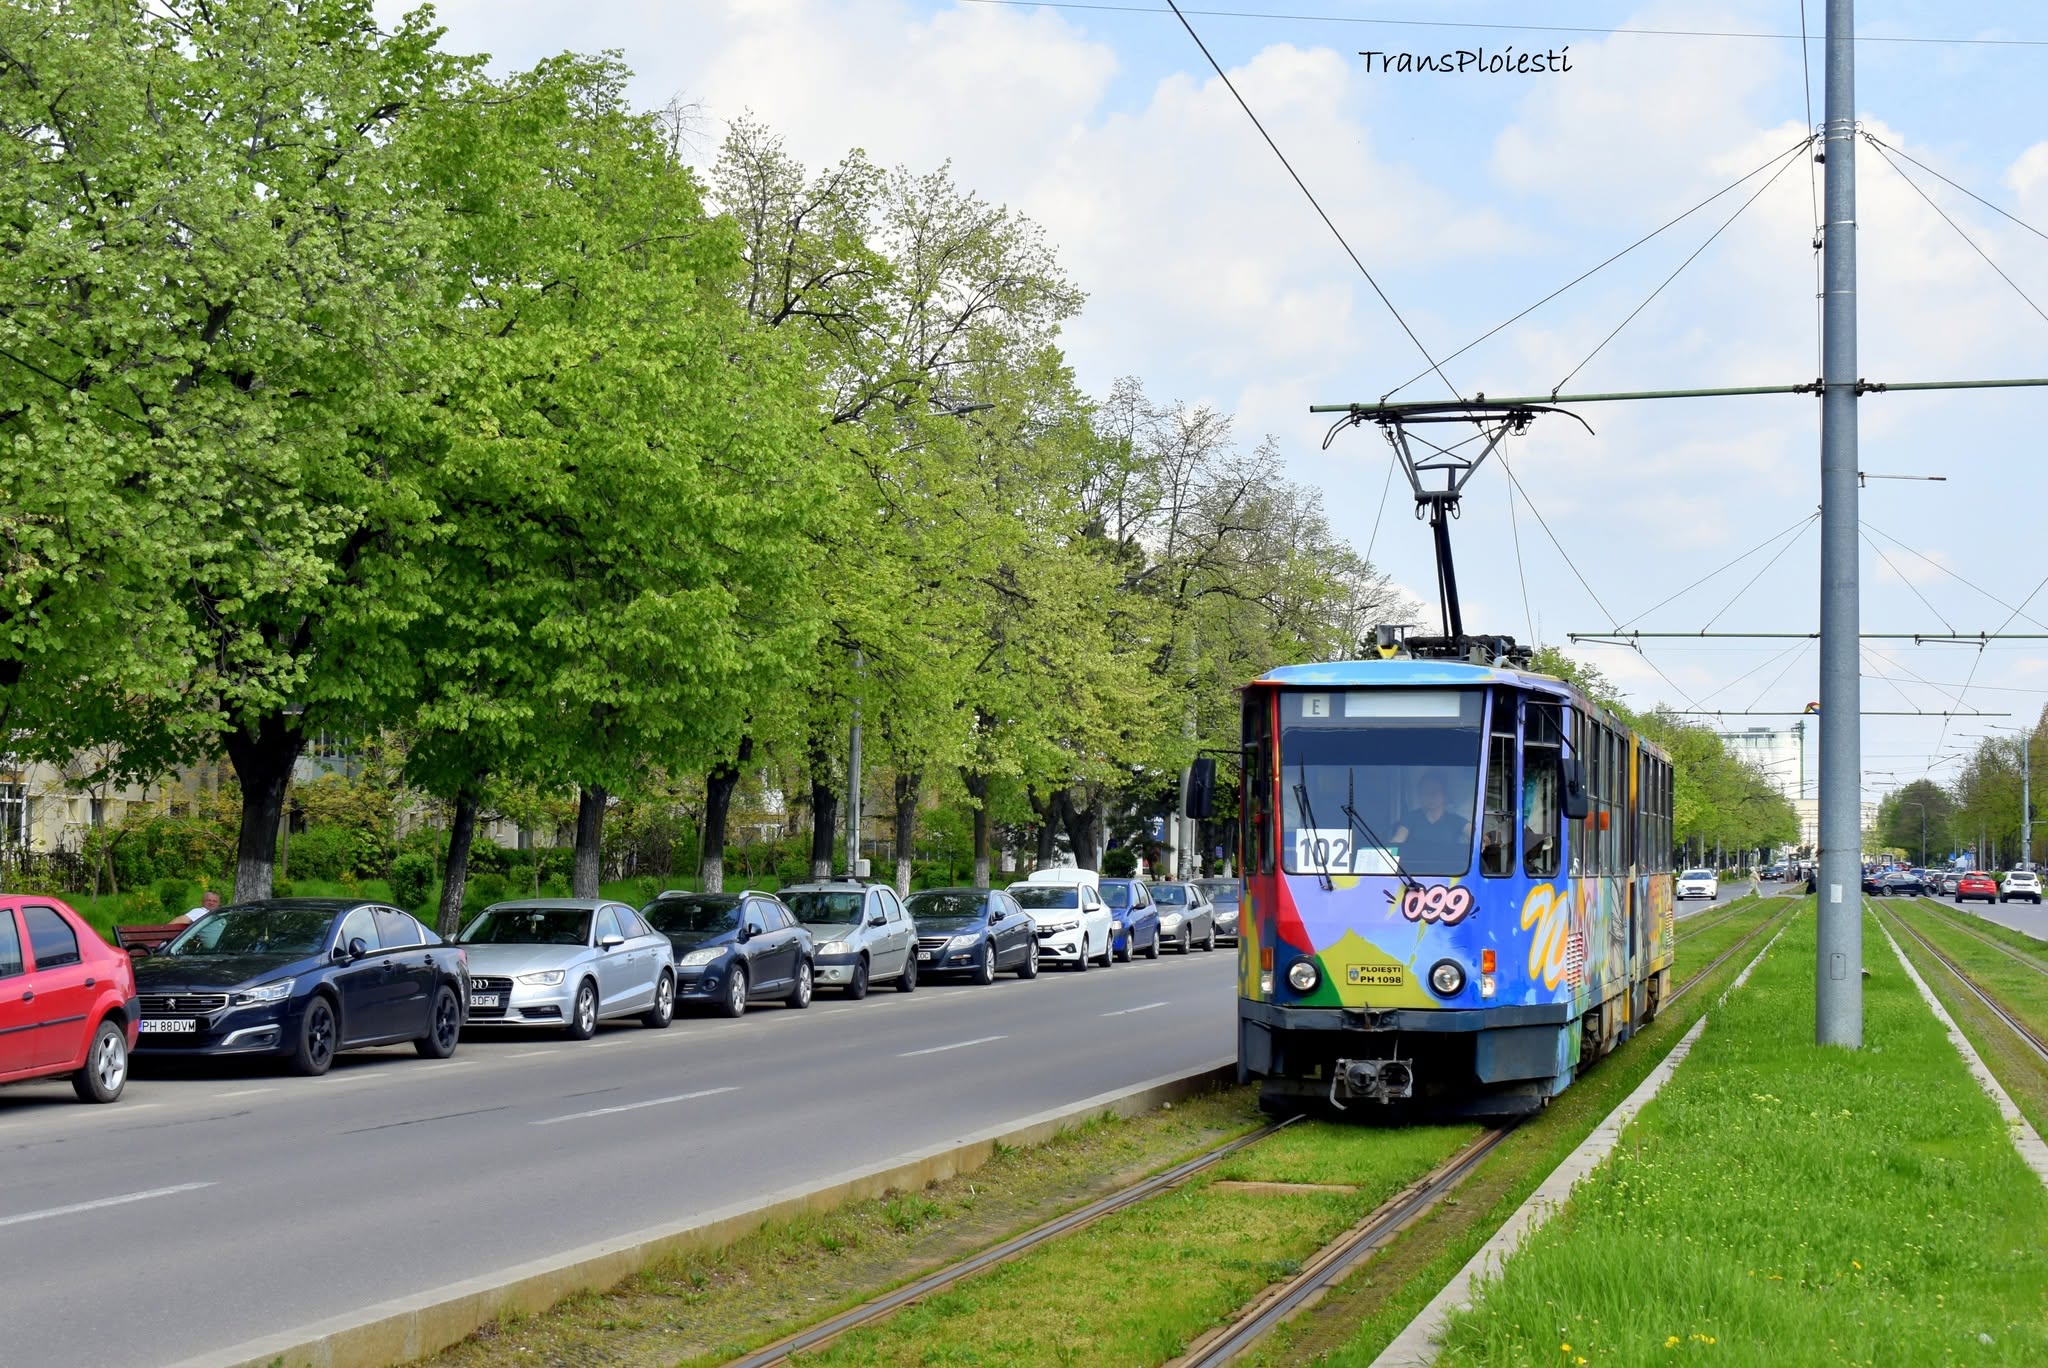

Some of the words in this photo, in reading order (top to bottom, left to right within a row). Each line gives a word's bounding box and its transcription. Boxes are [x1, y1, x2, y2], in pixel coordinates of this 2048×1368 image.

[1311, 699, 1321, 715] E
[1299, 837, 1349, 867] 102
[1402, 883, 1474, 927] 099
[1377, 976, 1402, 984] 1098
[142, 1021, 157, 1032] PH
[160, 1021, 195, 1032] 88DVM
